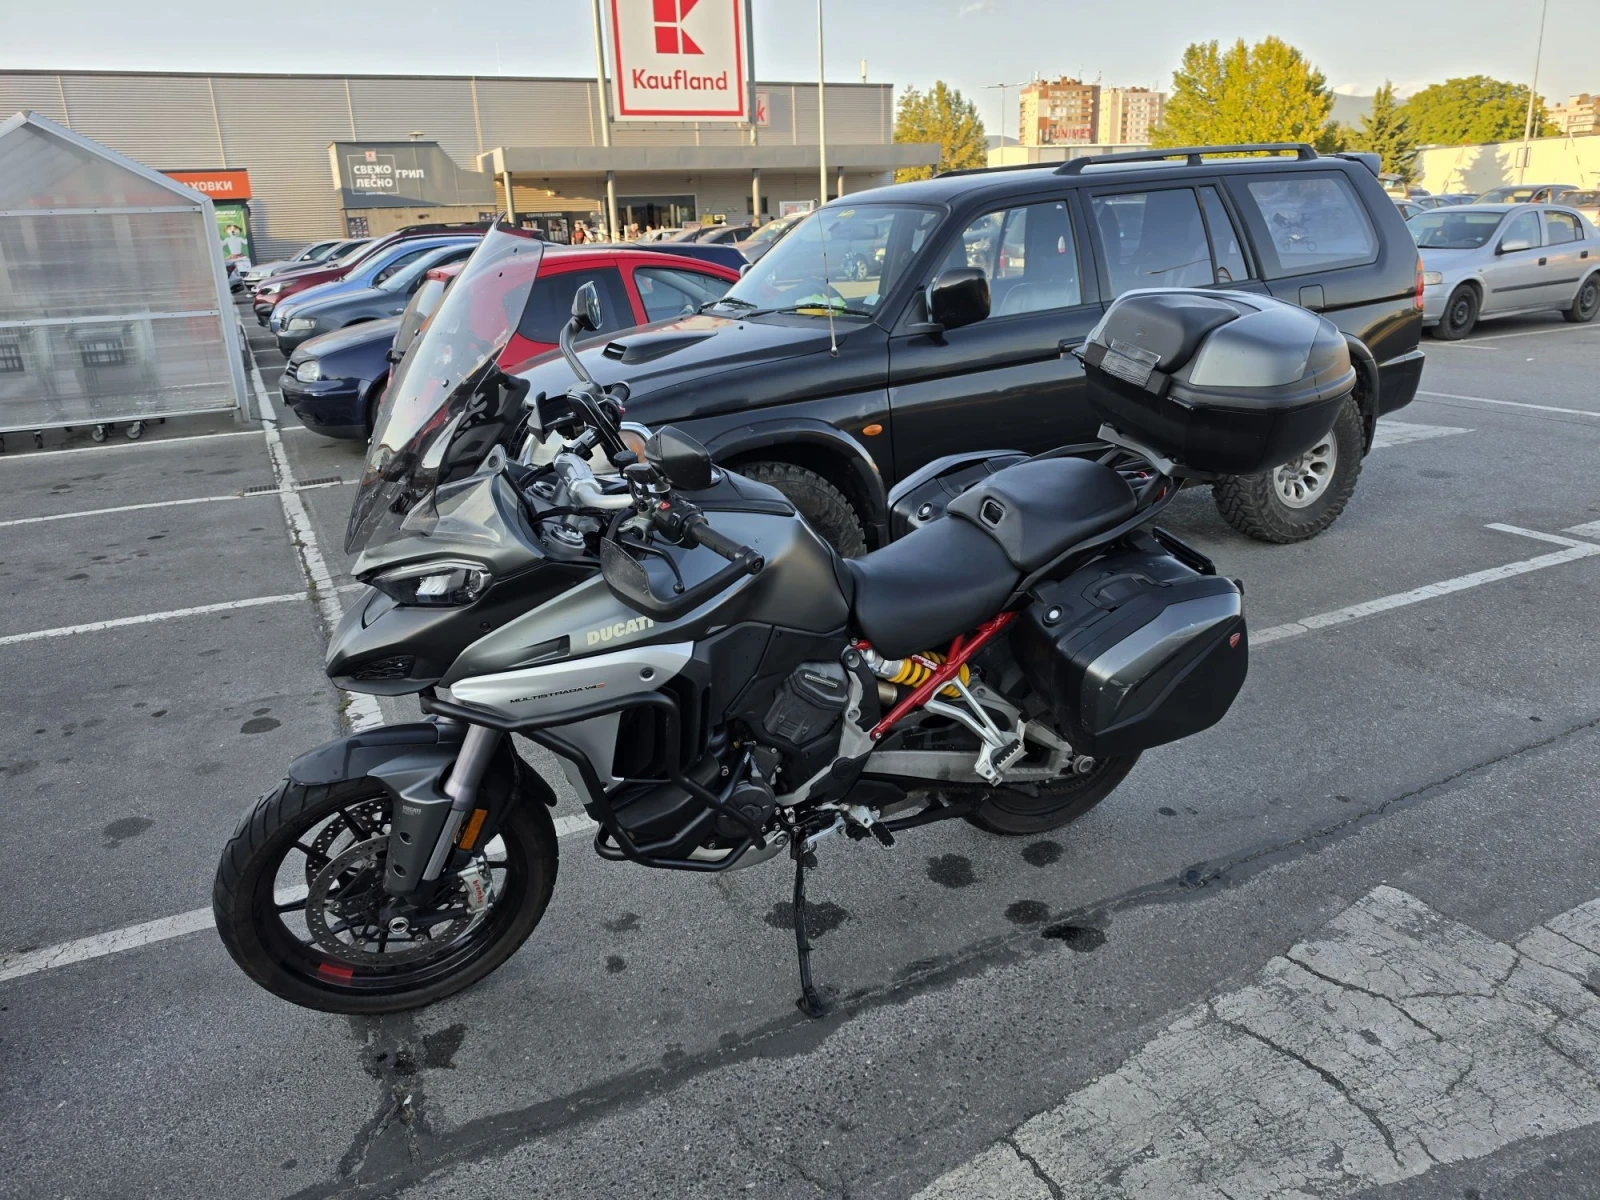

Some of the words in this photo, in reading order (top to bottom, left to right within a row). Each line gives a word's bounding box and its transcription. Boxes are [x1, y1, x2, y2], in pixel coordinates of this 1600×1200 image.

[632, 69, 728, 90] Kaufland
[353, 165, 392, 175] СВЕЖО
[395, 169, 425, 179] ГРИЛ
[356, 178, 393, 188] ЛЕСНО
[586, 616, 654, 646] DUCATI
[509, 687, 583, 704] MULTISTRADA
[473, 880, 483, 904] brembo
